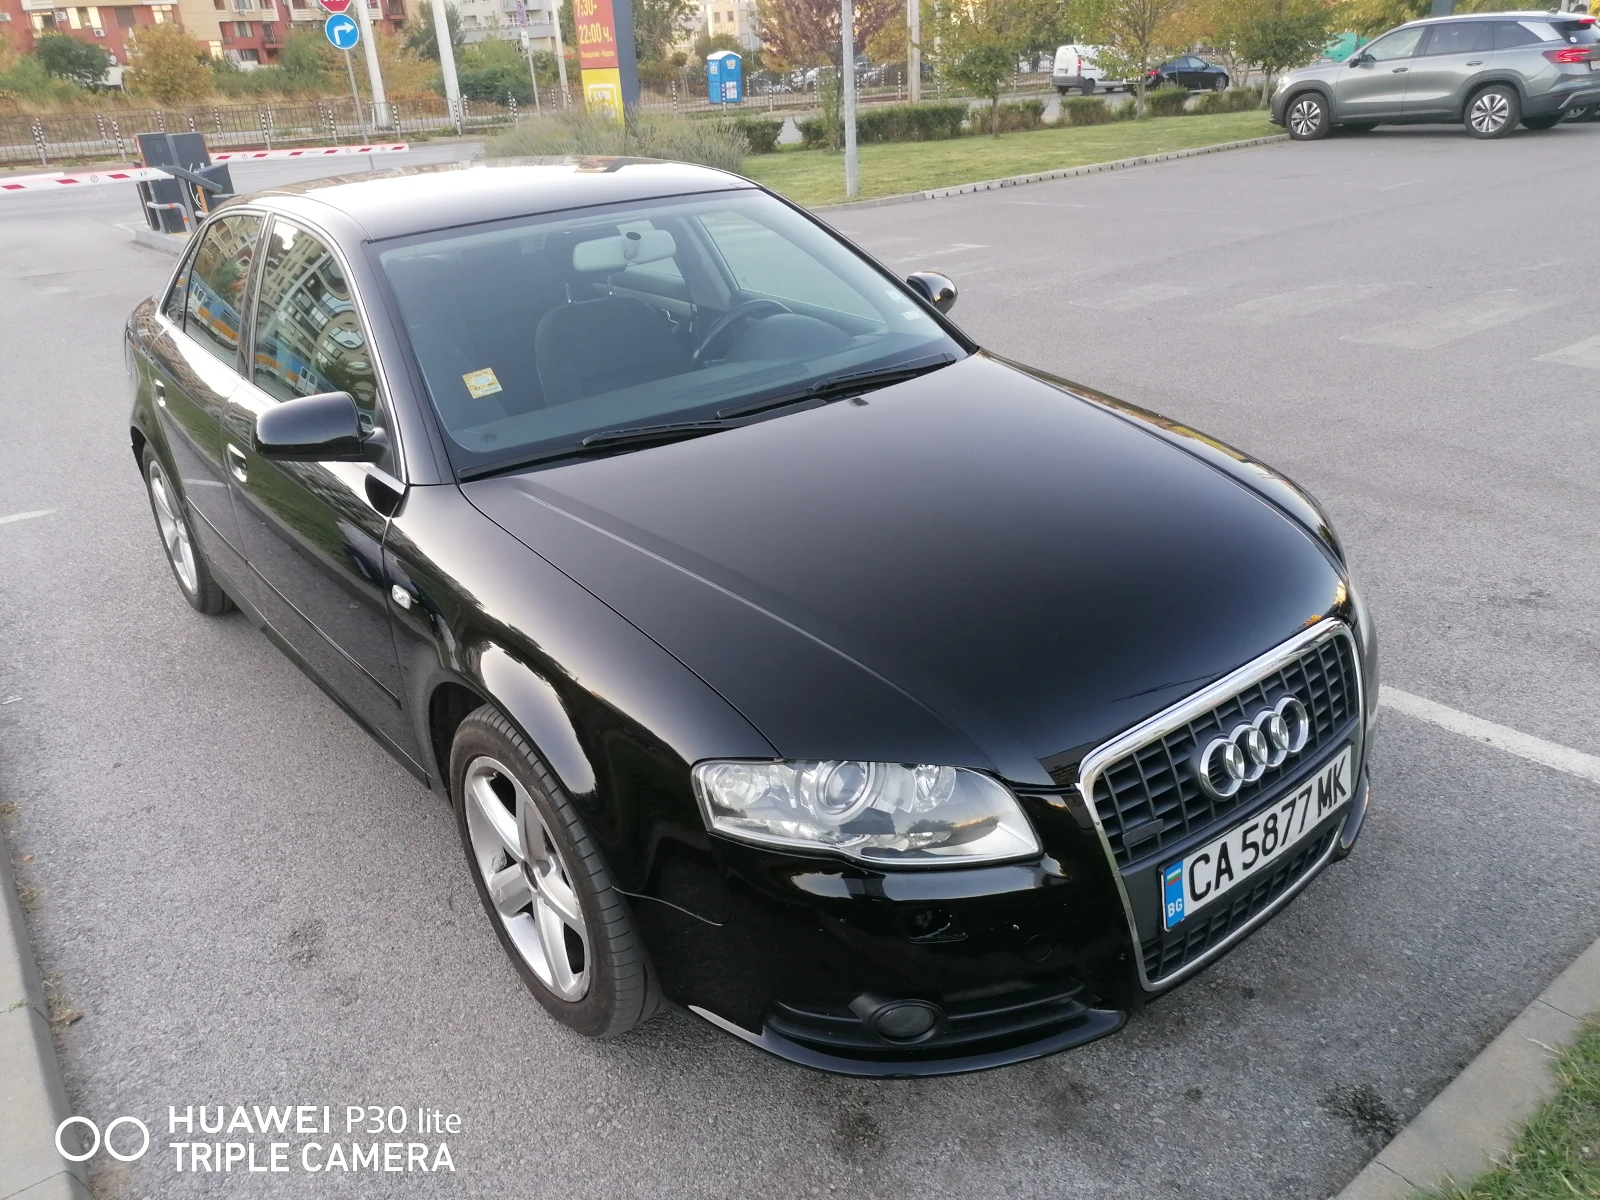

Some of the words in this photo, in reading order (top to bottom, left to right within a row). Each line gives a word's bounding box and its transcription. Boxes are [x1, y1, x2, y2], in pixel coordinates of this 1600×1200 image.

[579, 22, 602, 44] 22:00
[1188, 840, 1235, 902] CA
[1241, 784, 1313, 871] 5877
[1317, 755, 1346, 819] MK
[1167, 897, 1183, 918] BG
